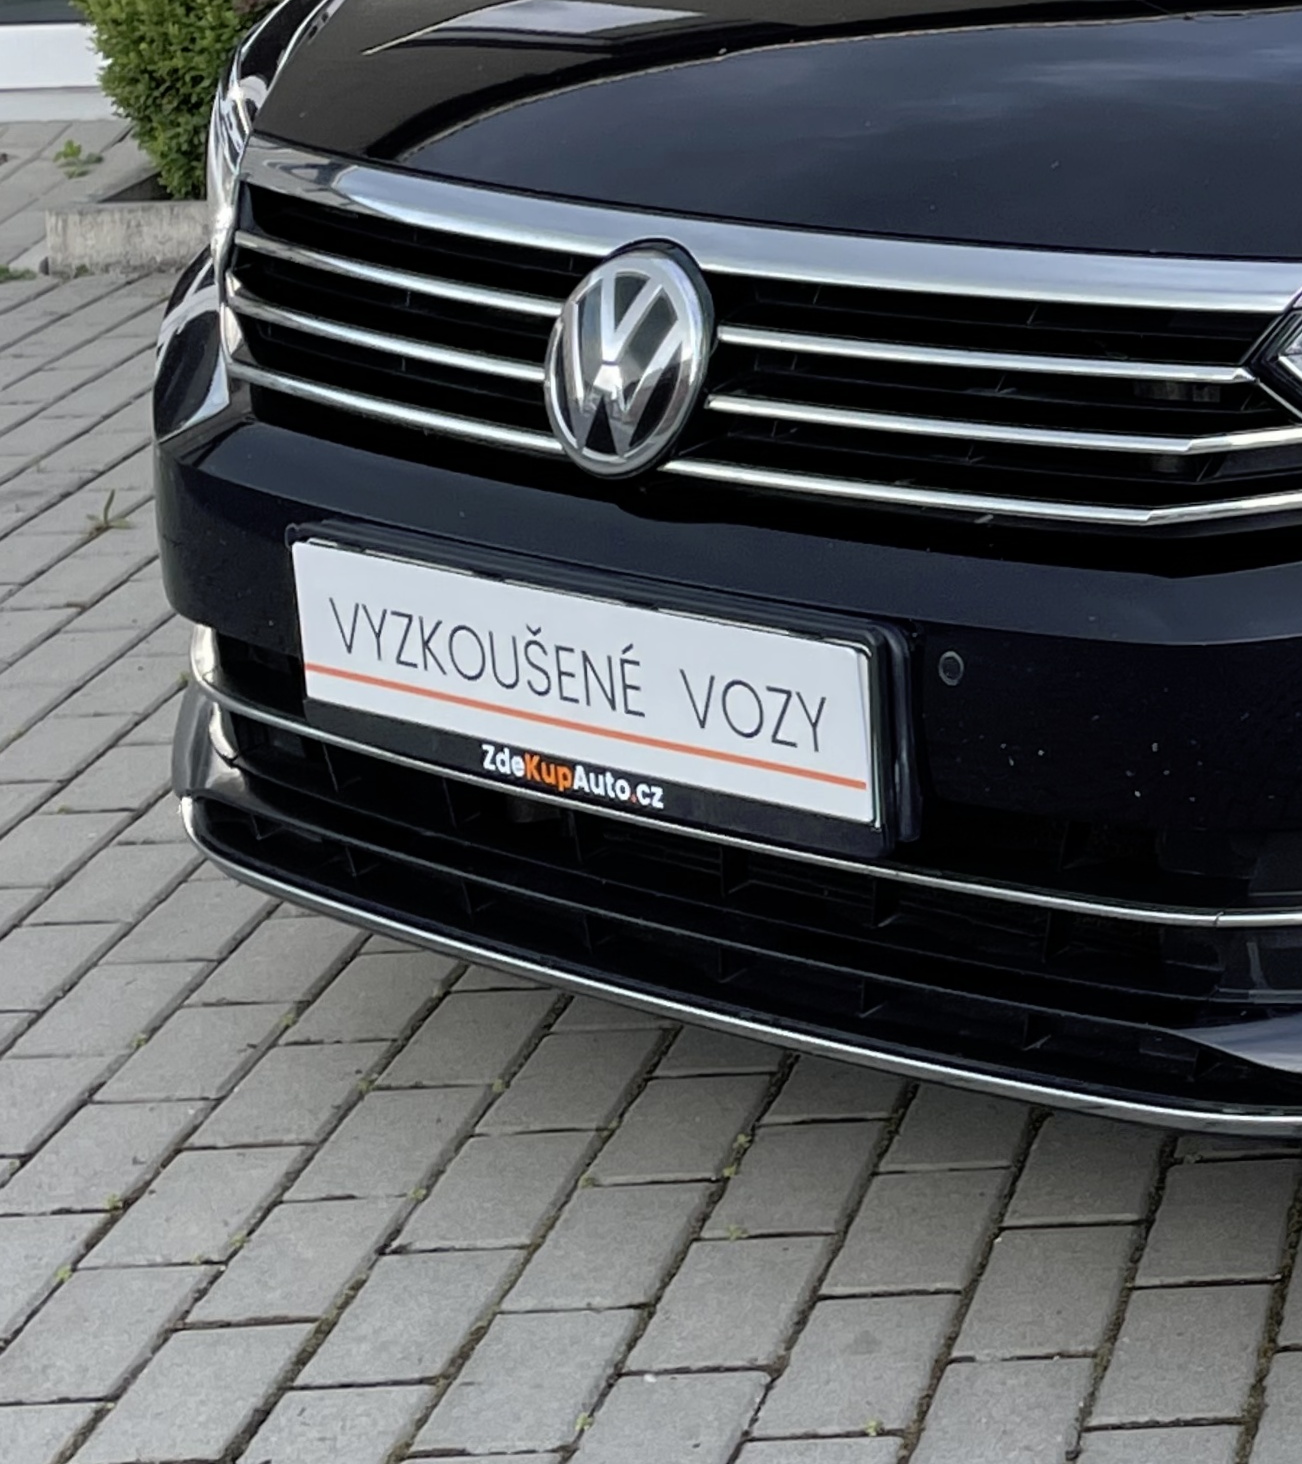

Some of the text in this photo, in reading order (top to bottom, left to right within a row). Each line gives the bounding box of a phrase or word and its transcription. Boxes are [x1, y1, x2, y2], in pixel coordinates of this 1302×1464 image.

[329, 597, 827, 753] VYZKOUŠENÉ VOZY
[482, 744, 664, 809] ZdeKupAuto.cz
